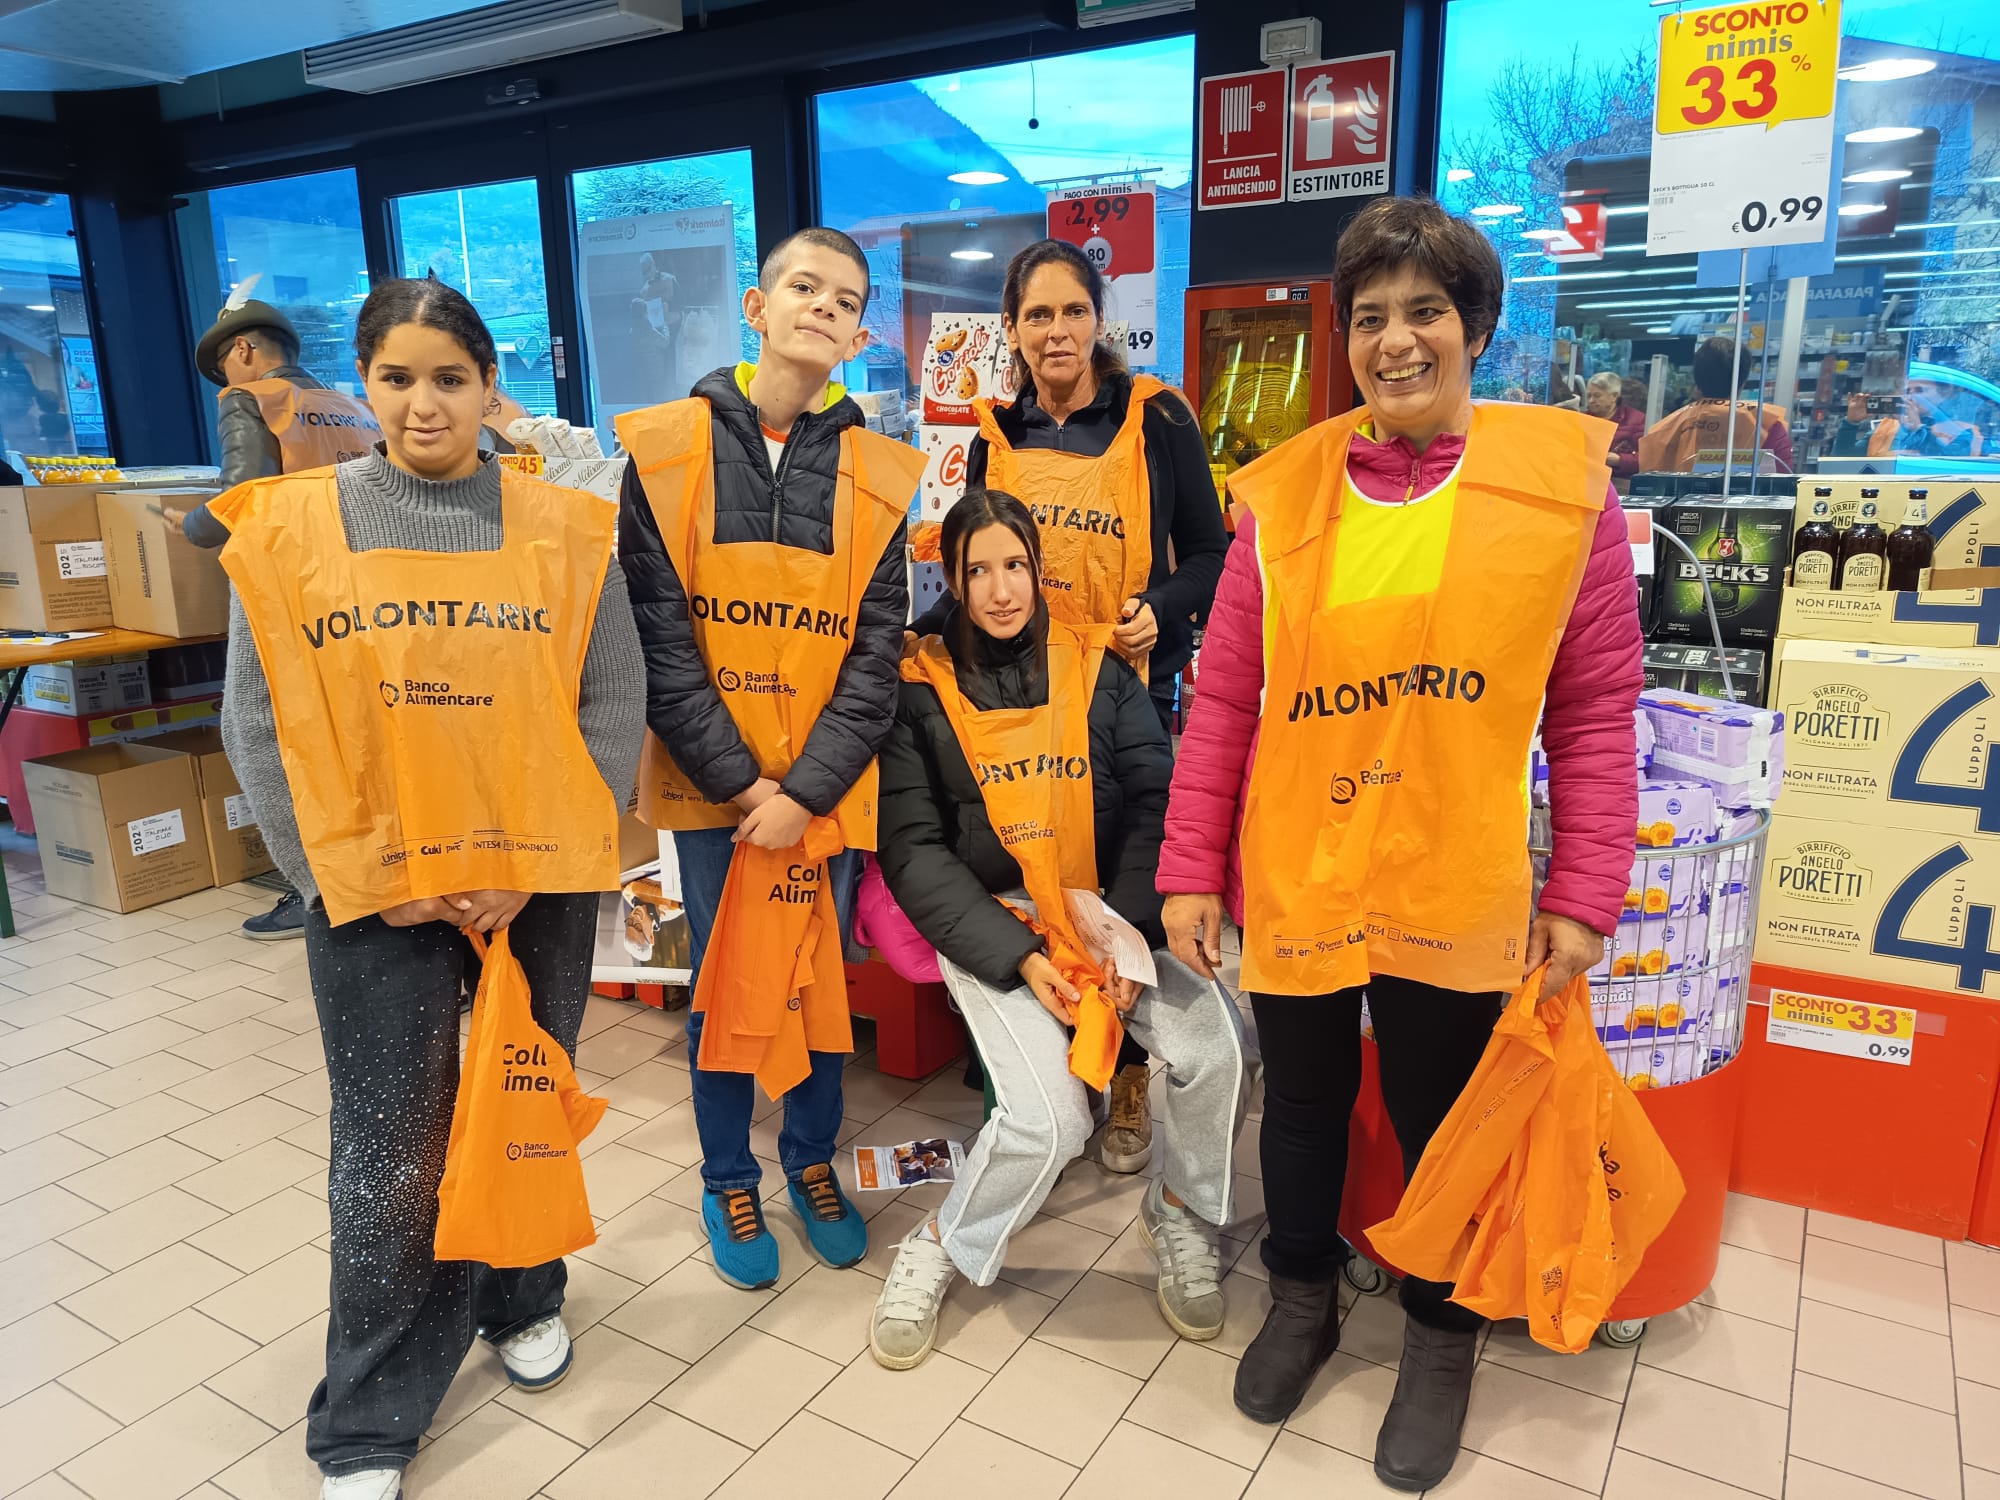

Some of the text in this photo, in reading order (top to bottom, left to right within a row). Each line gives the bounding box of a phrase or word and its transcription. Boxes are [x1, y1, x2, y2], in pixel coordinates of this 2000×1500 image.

[1694, 2, 1809, 37] SCONTO
[1706, 28, 1793, 62] nimis
[1223, 165, 1261, 181] LANCIA
[1207, 180, 1277, 198] ANTINCENDIO
[1293, 169, 1385, 195] ESTINTORE
[1064, 184, 1132, 199] PAGO CON nimis
[1087, 247, 1106, 261] 80
[936, 404, 970, 414] CHOCOLATE
[518, 456, 538, 475] 45
[1798, 563, 1829, 574] PORETTI
[1965, 522, 1980, 600] LPPOLI
[1679, 562, 1770, 583] BECK'S
[1848, 565, 1879, 577] PORETTI
[1795, 598, 1882, 611] NON FILTRATA
[404, 679, 450, 693] Banco
[744, 671, 779, 684] Banco
[404, 692, 494, 707] Alimentare
[1812, 686, 1869, 703] BIRRIFICIO
[1816, 699, 1861, 714] ANGELO
[1793, 711, 1880, 742] PORETTI
[1967, 716, 1987, 783] LUPPOLI
[1782, 769, 1878, 788] NON FILTRATA
[1800, 782, 1837, 791] EQUILIBRATA
[1842, 787, 1875, 795] FRAGRANTE
[421, 843, 442, 856] Cuki
[473, 840, 559, 853] INTESA SANPAOLO
[1797, 843, 1852, 860] BIRRIFICIO
[1800, 855, 1844, 871] ANGELO
[1778, 865, 1863, 898] PORETTI
[1947, 878, 1966, 942] LUPPOLI
[1768, 920, 1861, 942] NON FILTRATA
[1401, 932, 1453, 952] SANPAOLO
[1776, 993, 1848, 1015] SCONTO
[1787, 1008, 1834, 1025] nimis
[523, 1149, 568, 1159] Alimentare
[524, 1142, 550, 1151] Banco
